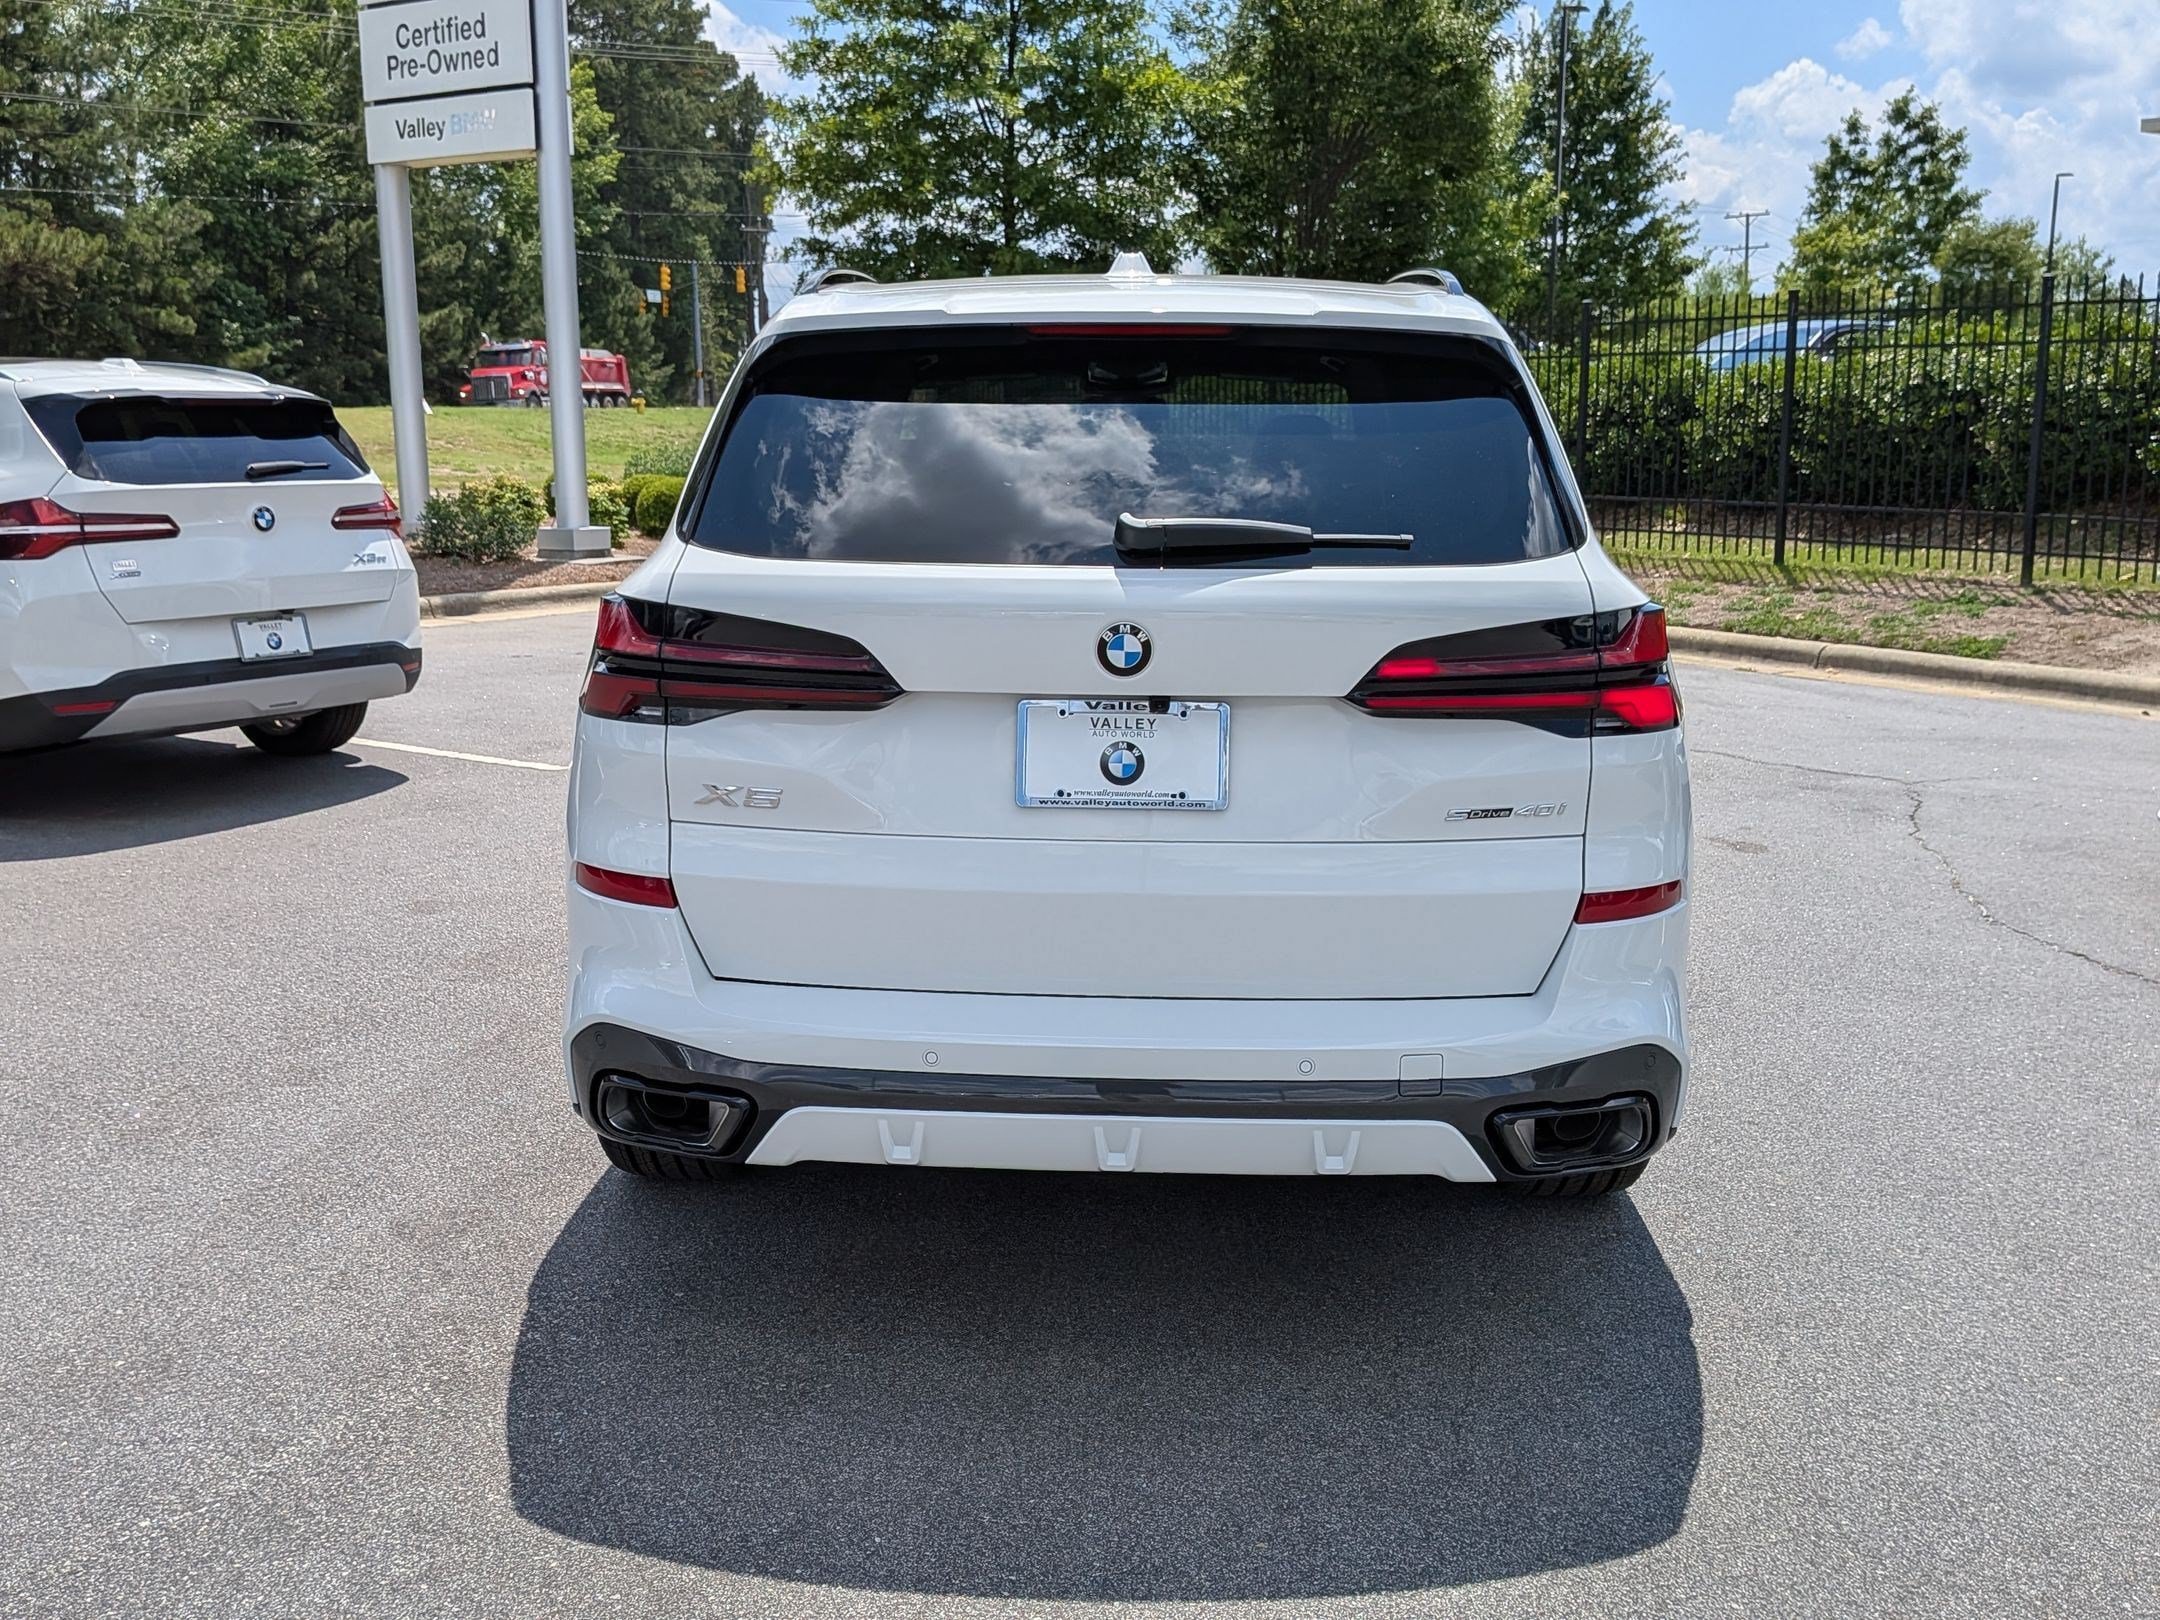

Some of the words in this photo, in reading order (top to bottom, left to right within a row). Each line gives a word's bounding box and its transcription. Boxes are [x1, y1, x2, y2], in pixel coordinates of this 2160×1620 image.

[395, 12, 487, 49] Certified
[387, 41, 500, 80] Pre-Owned
[395, 117, 446, 141] Valley
[1101, 624, 1148, 643] BMW
[1084, 700, 1149, 711] Valle
[1090, 716, 1157, 730] VALLEY
[1091, 730, 1117, 738] AUTO
[1121, 731, 1155, 739] WORLD
[1104, 741, 1142, 757] BMW
[693, 783, 784, 809] X5
[1073, 789, 1170, 800] www.valleyautoworld.com
[1038, 799, 1206, 809] www.valleyautoworld.com
